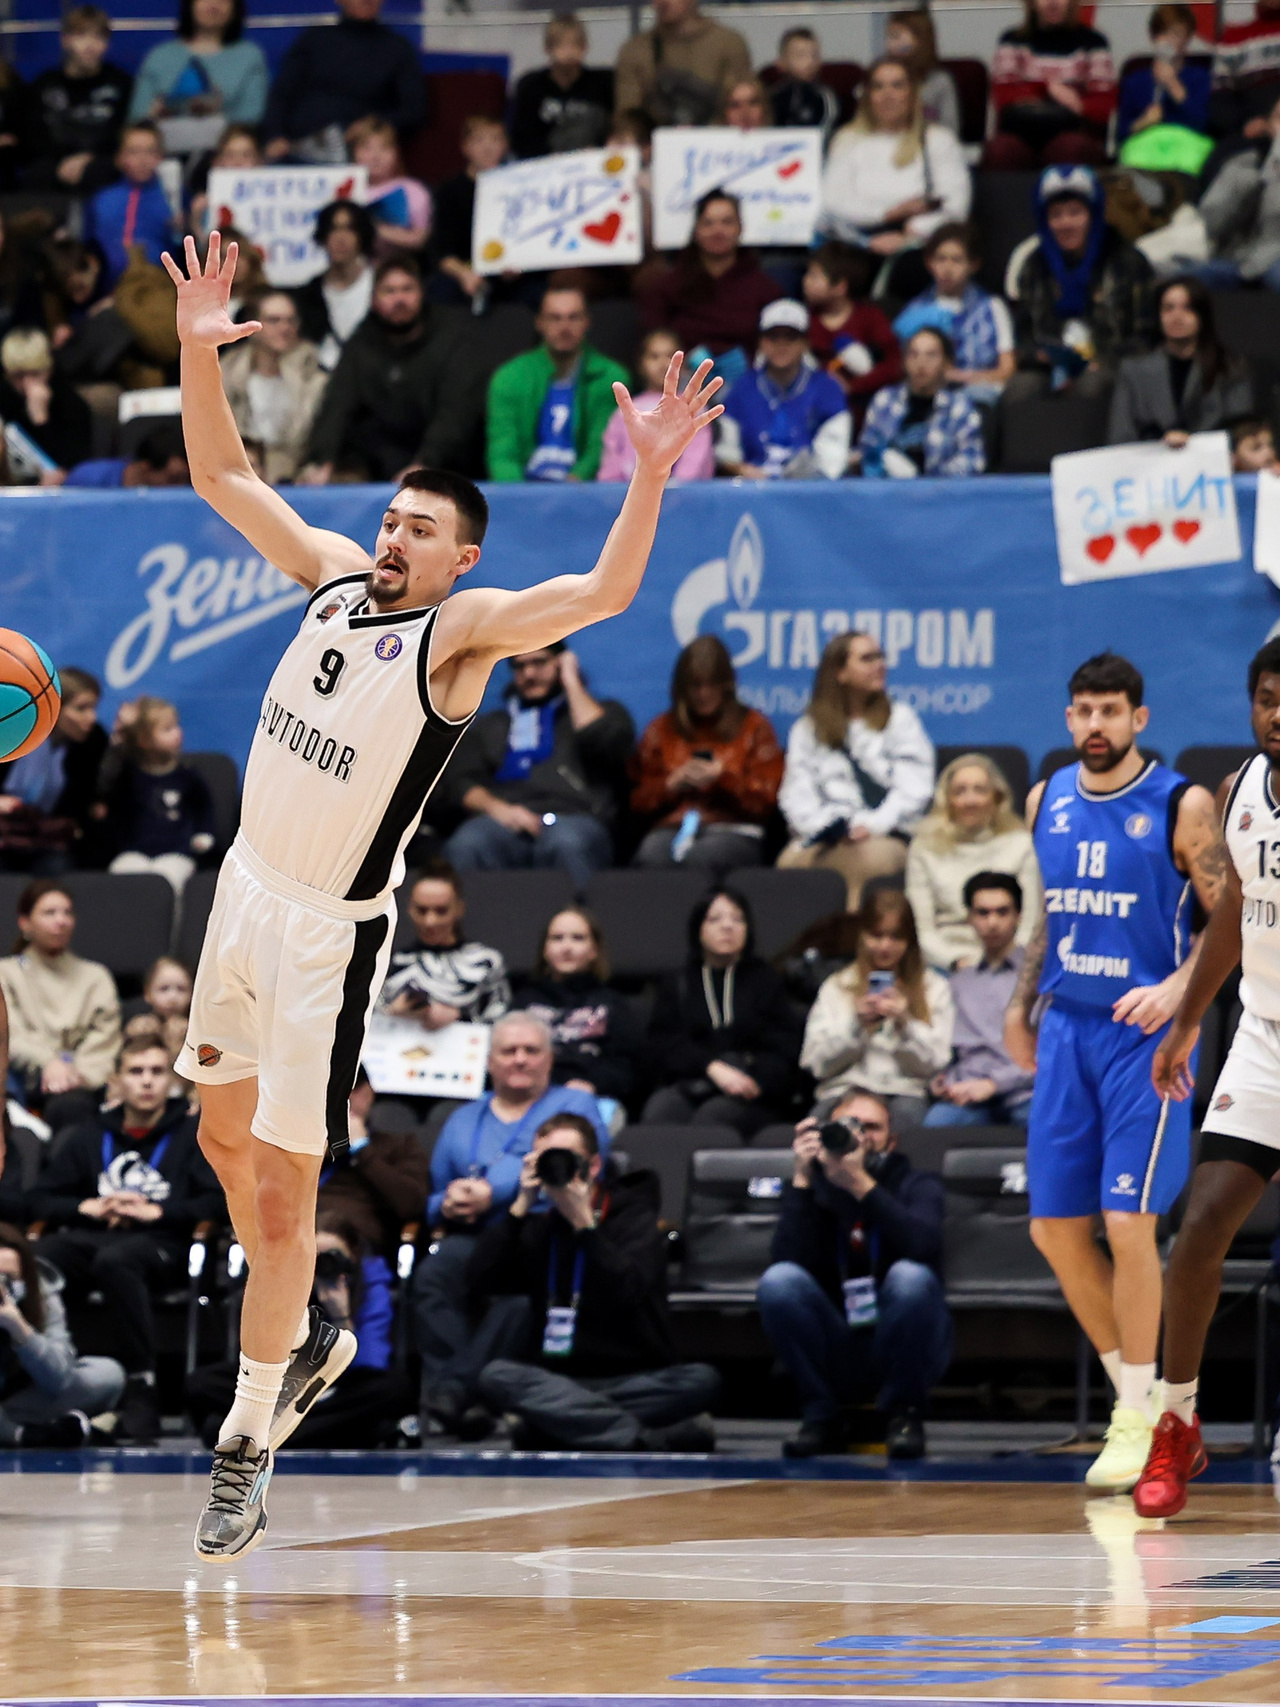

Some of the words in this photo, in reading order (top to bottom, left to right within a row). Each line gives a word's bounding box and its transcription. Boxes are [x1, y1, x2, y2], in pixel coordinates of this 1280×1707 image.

[1075, 470, 1230, 534] ЗЕНИТ
[105, 542, 298, 689] Зени
[312, 647, 348, 700] 9
[1076, 840, 1108, 879] 18
[1044, 887, 1139, 918] ZENIT
